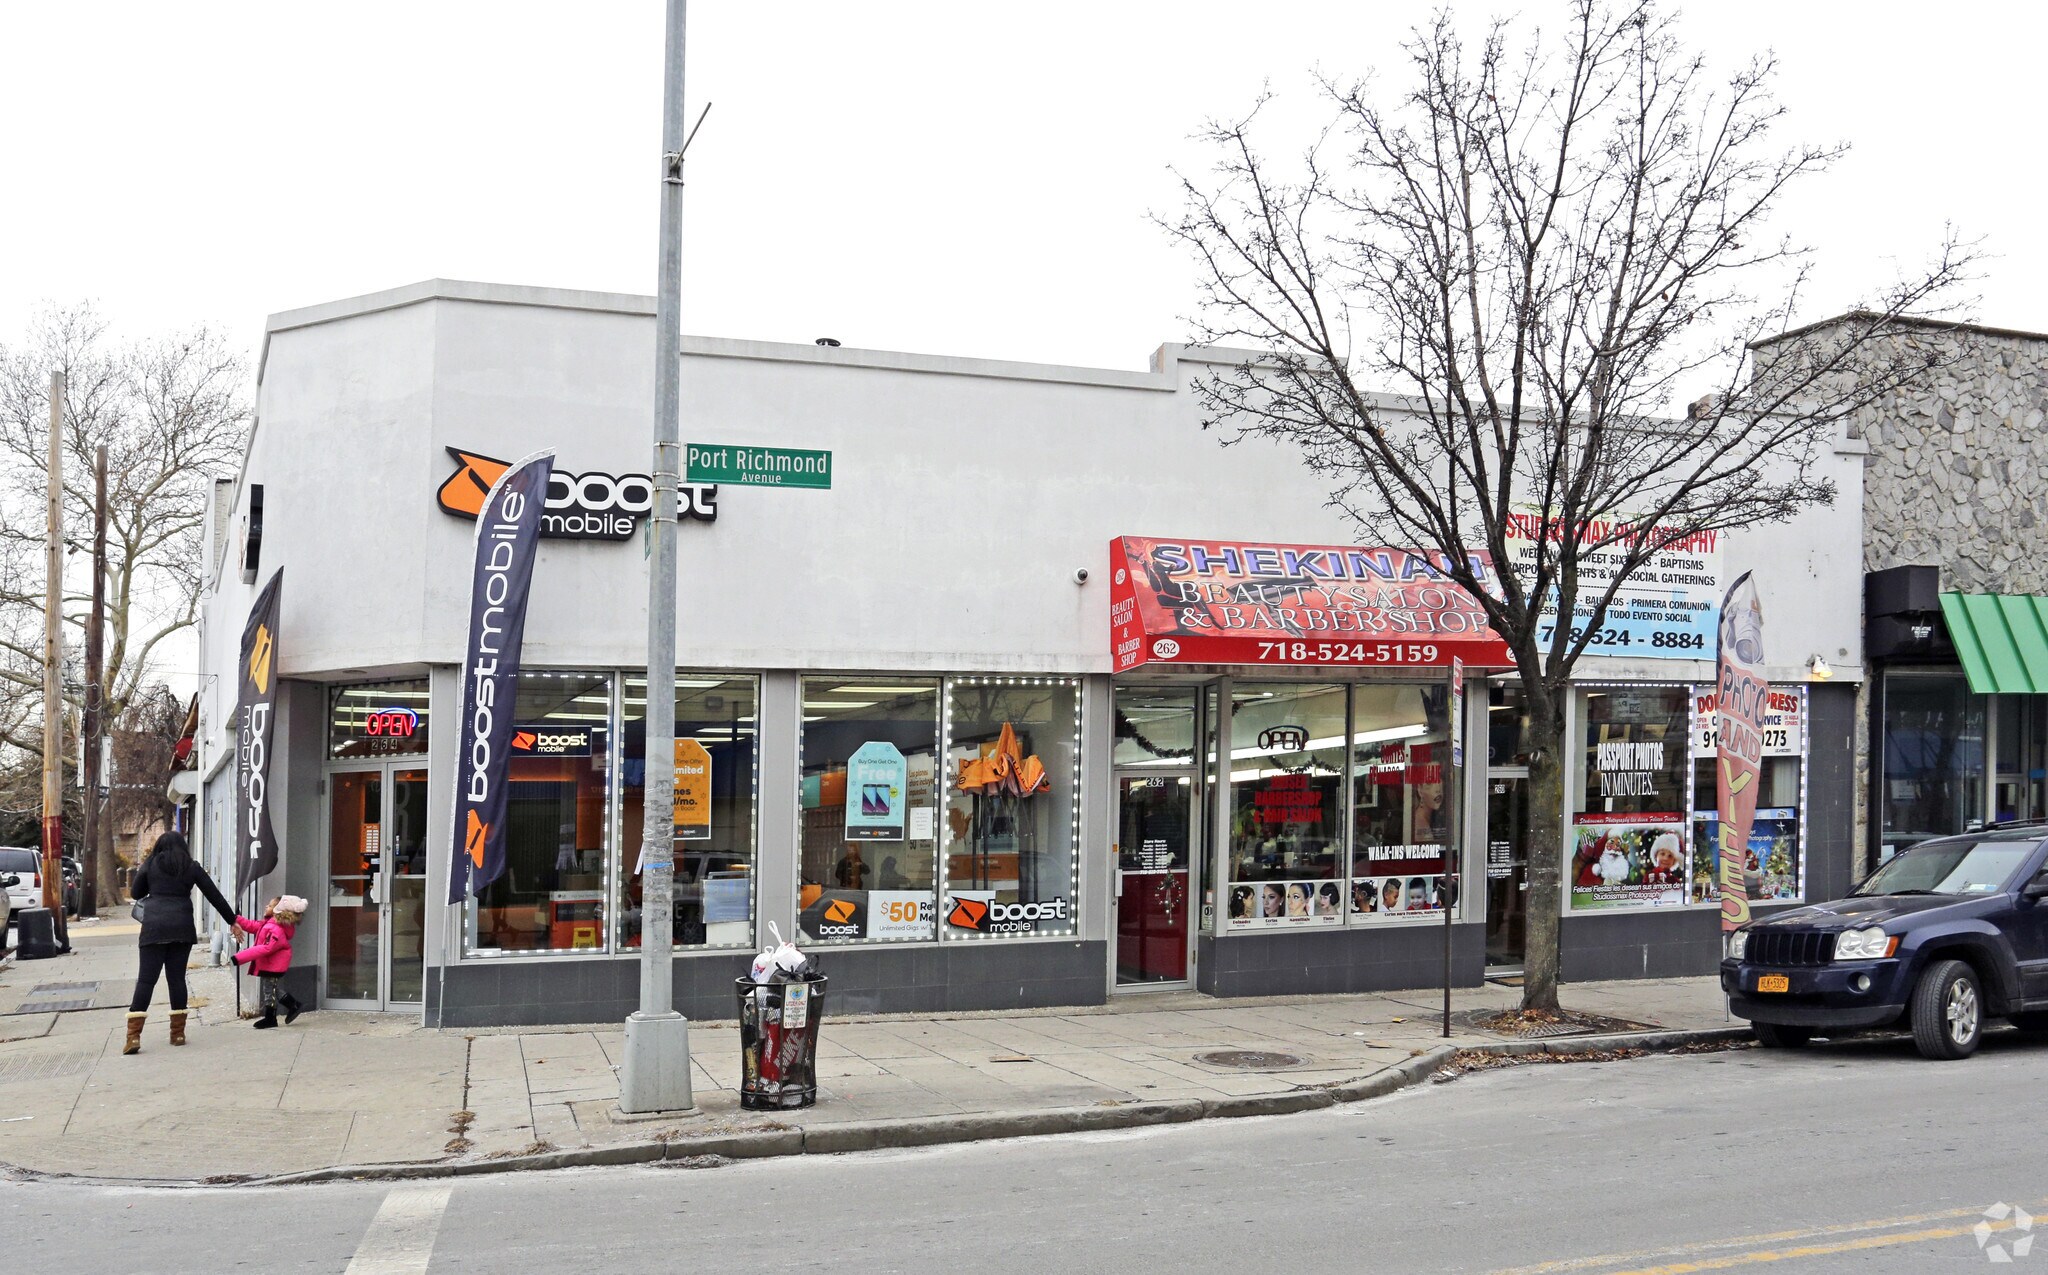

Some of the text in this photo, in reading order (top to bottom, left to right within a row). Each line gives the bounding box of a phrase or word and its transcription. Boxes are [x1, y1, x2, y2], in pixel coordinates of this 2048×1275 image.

[689, 447, 827, 474] Port Richmond
[741, 472, 782, 484] Avenue
[1660, 558, 1704, 571] BAPTISMS
[1628, 571, 1659, 583] SOCIAL
[1661, 573, 1716, 586] GATHERINGS
[1174, 580, 1481, 611] BEAUTY SALON
[1111, 596, 1136, 617] BEAUTY
[1631, 598, 1667, 609] PRIMERA
[1669, 600, 1711, 611] COMUNION
[1113, 610, 1133, 628] SALON
[1180, 606, 1212, 629] &
[1609, 609, 1630, 620] TODO
[1632, 611, 1663, 621] EVENTO
[1664, 612, 1692, 623] SOCIAL
[1123, 627, 1129, 639] &
[1117, 637, 1141, 656] BARBER
[1156, 642, 1177, 655] 262
[1258, 641, 1438, 662] 718-524-5159
[1121, 651, 1137, 668] SHOP
[1720, 664, 1766, 729] PHOO
[366, 712, 413, 737] OPEN
[372, 739, 398, 750] 264
[537, 732, 588, 746] boost
[1257, 730, 1306, 751] OPEN
[1719, 717, 1761, 763] AND
[537, 745, 565, 753] mobile
[1596, 742, 1664, 771] PASSPORT PHOTOS
[248, 702, 270, 859] boost
[857, 764, 898, 780] Free
[1146, 777, 1164, 787] 262
[1600, 772, 1611, 797] IN
[1367, 844, 1441, 861] WALK-INS WELCOME
[1572, 885, 1593, 894] Felices
[1621, 884, 1642, 892] desean
[1652, 883, 1673, 892] amigos
[1628, 890, 1662, 901] Photography
[880, 901, 918, 923] $50
[989, 897, 1067, 921] boost
[819, 923, 859, 935] boost
[879, 924, 906, 932] Unlimited
[906, 924, 919, 932] Gigs
[989, 921, 1032, 933] mobile
